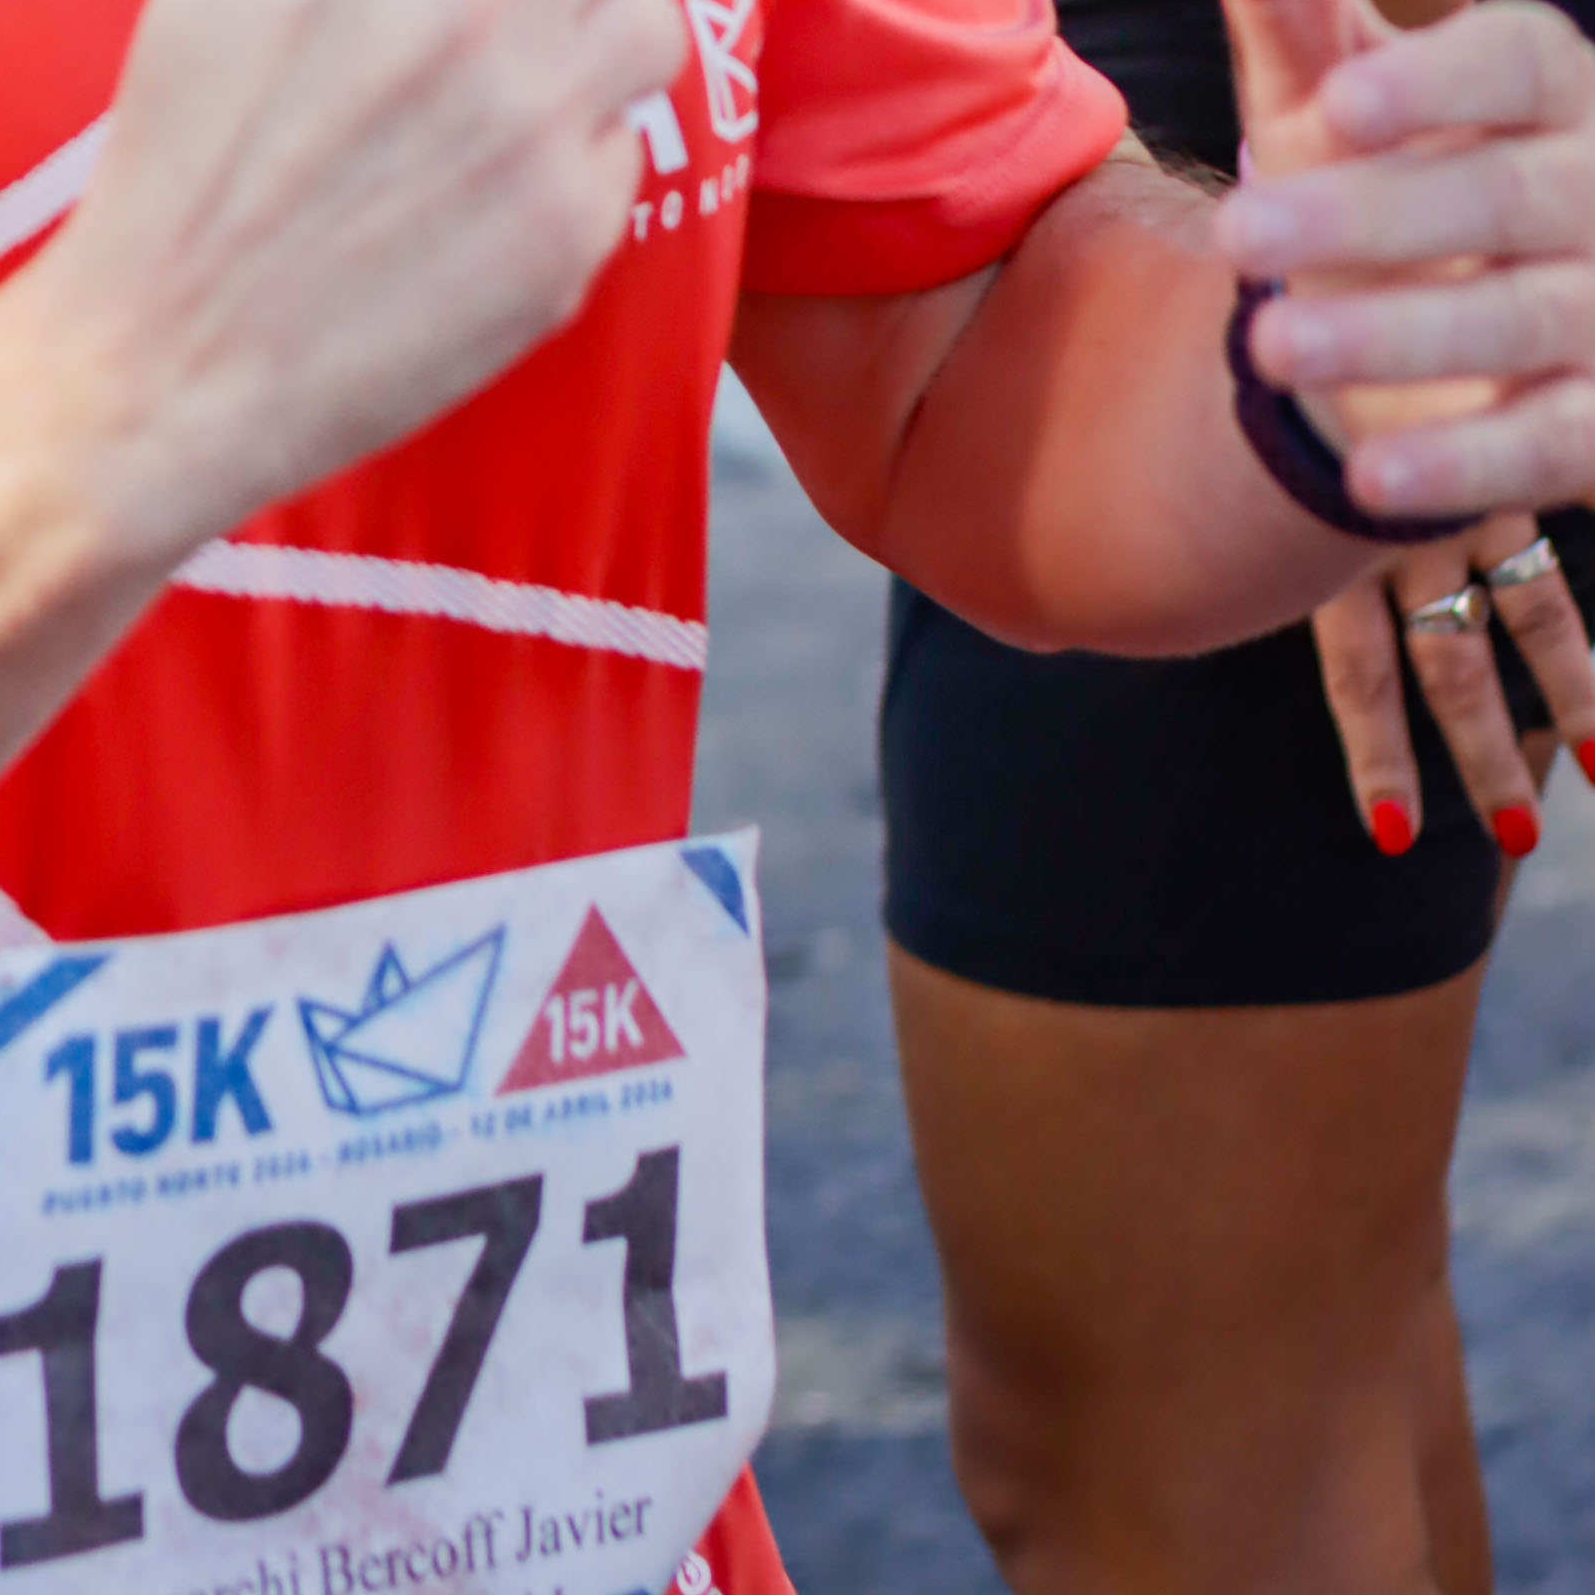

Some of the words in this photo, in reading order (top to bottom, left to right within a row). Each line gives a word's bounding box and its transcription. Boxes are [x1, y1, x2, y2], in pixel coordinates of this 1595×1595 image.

[542, 978, 645, 1065] 15K
[42, 1002, 278, 1167] 15K
[42, 1175, 147, 1215] PUERTO
[155, 1163, 241, 1197] NORTE
[338, 1120, 443, 1164] ROSARIO
[543, 1092, 610, 1122] ABRIL
[317, 1507, 504, 1595] Bercoff
[514, 1487, 653, 1563] Javier
